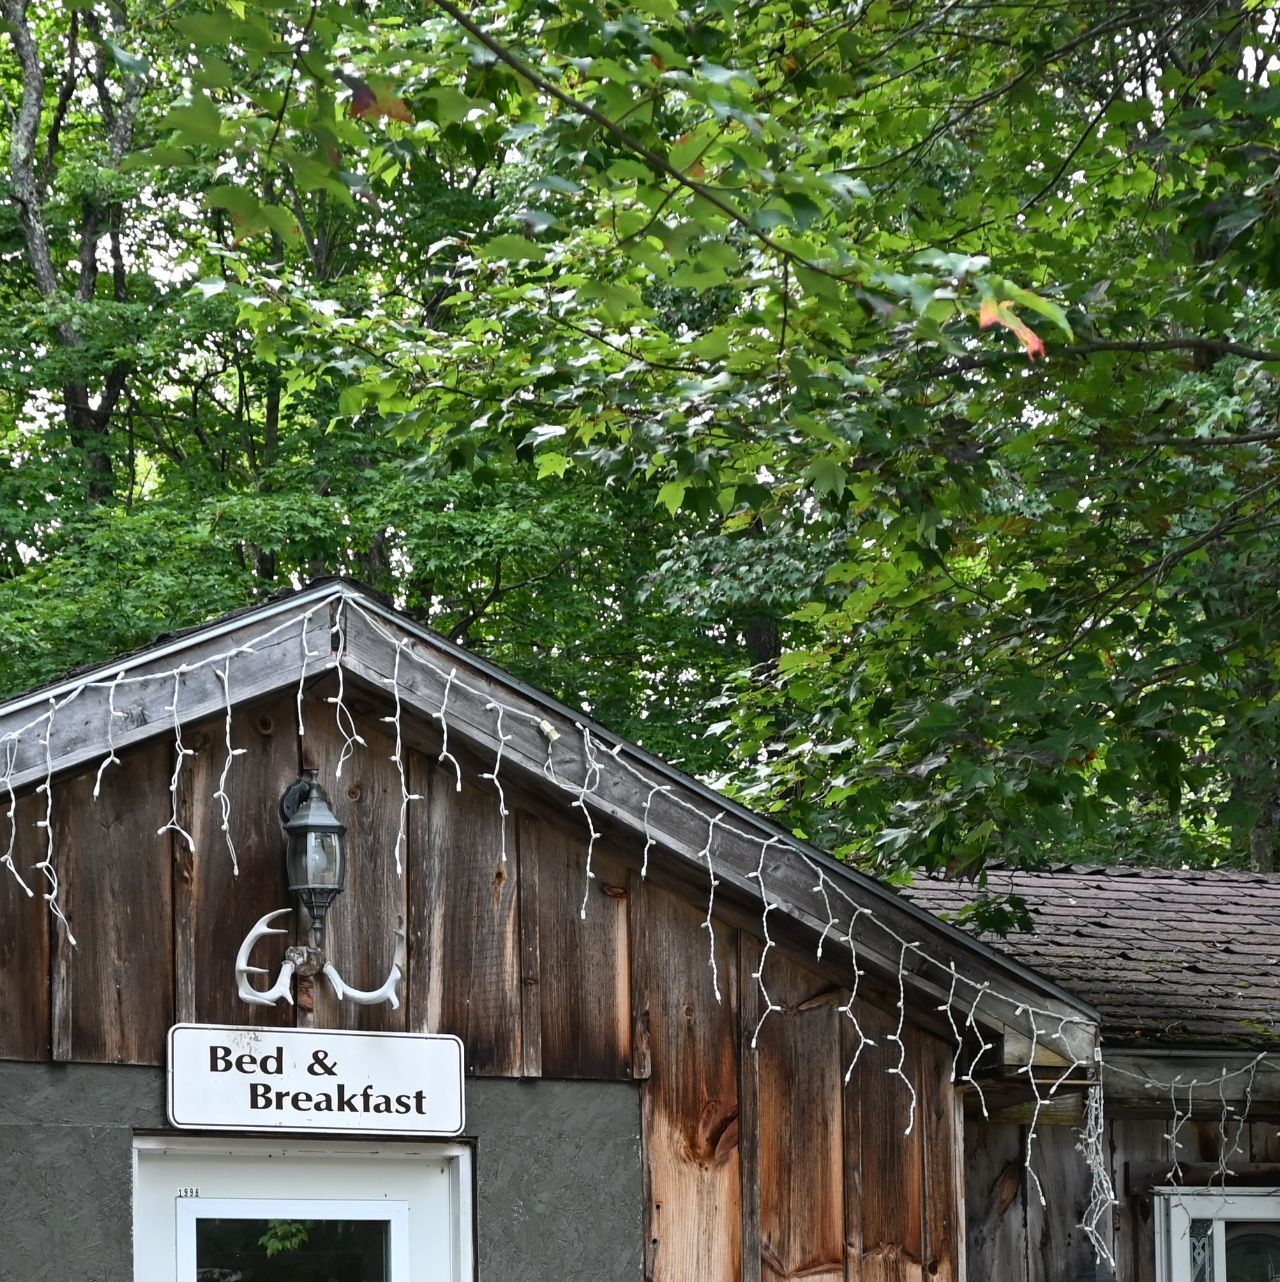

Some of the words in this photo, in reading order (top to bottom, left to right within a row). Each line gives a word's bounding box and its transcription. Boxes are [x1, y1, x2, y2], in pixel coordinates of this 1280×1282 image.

[209, 1046, 283, 1074] Bed
[307, 1049, 338, 1076] &
[249, 1083, 427, 1115] Breakfast
